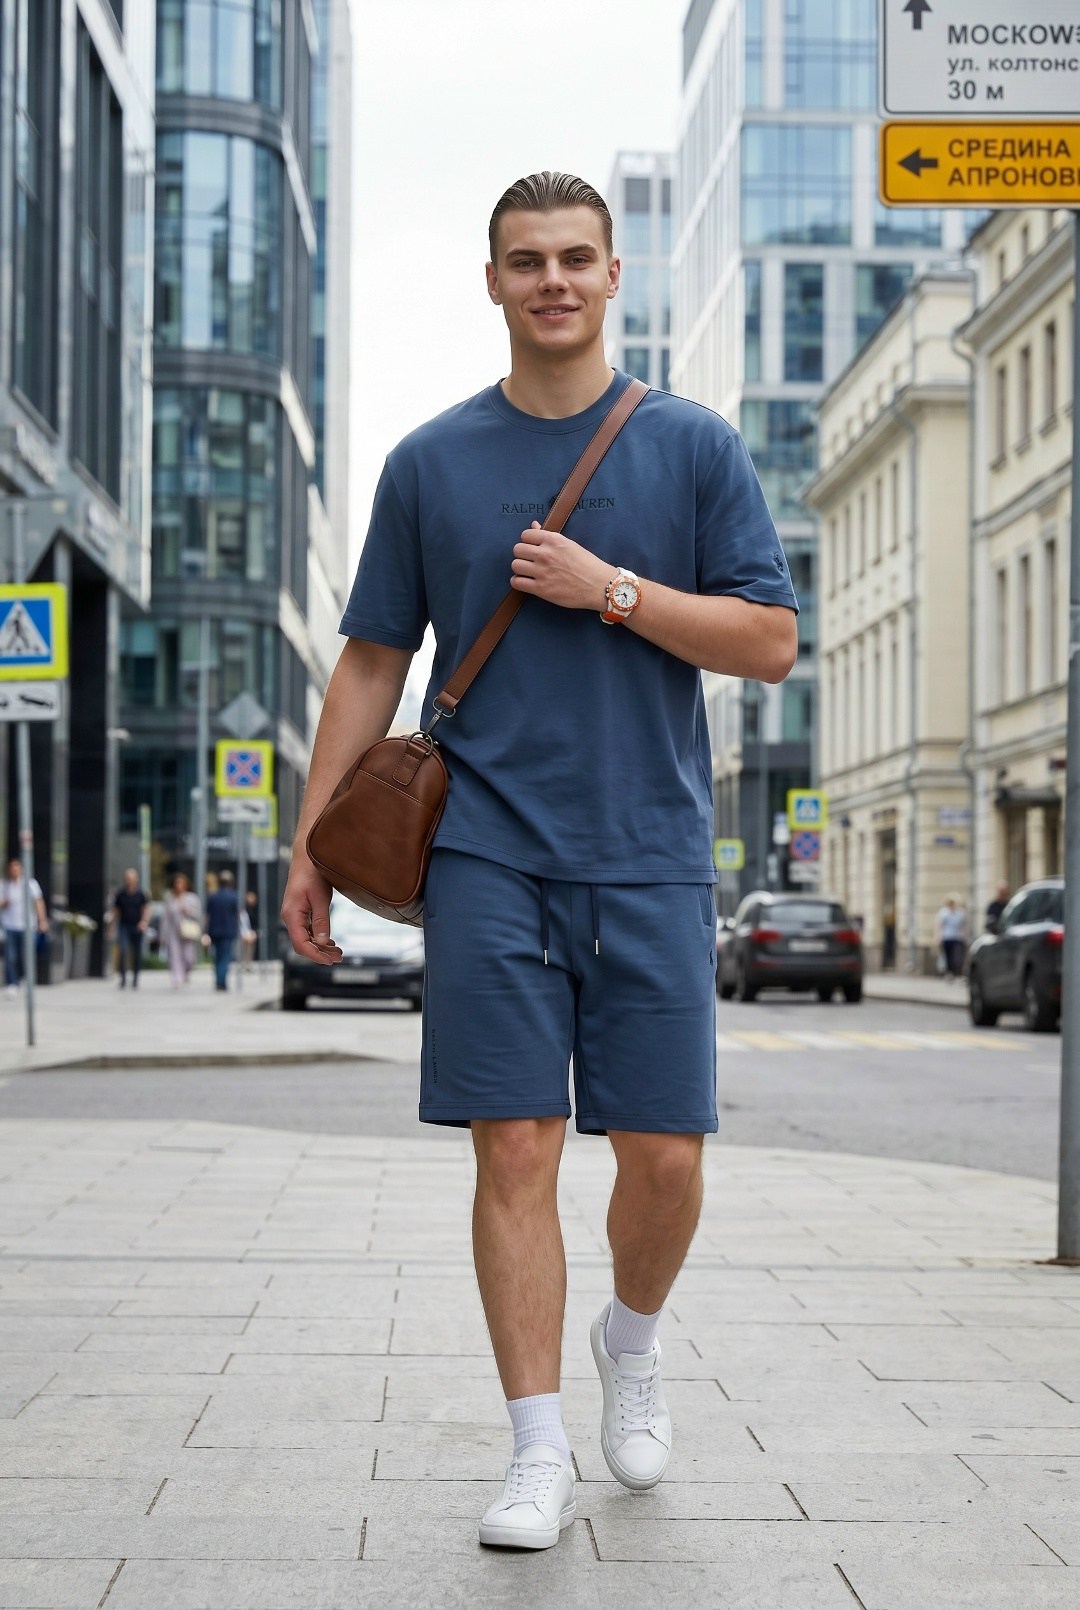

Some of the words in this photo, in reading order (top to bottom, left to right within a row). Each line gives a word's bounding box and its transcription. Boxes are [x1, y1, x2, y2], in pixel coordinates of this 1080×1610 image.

[947, 57, 980, 76] ул.
[947, 79, 977, 101] 30
[985, 84, 1005, 100] м
[947, 138, 1072, 162] СРЕДИНА
[501, 502, 545, 515] RALPH
[576, 497, 616, 511] AUREN
